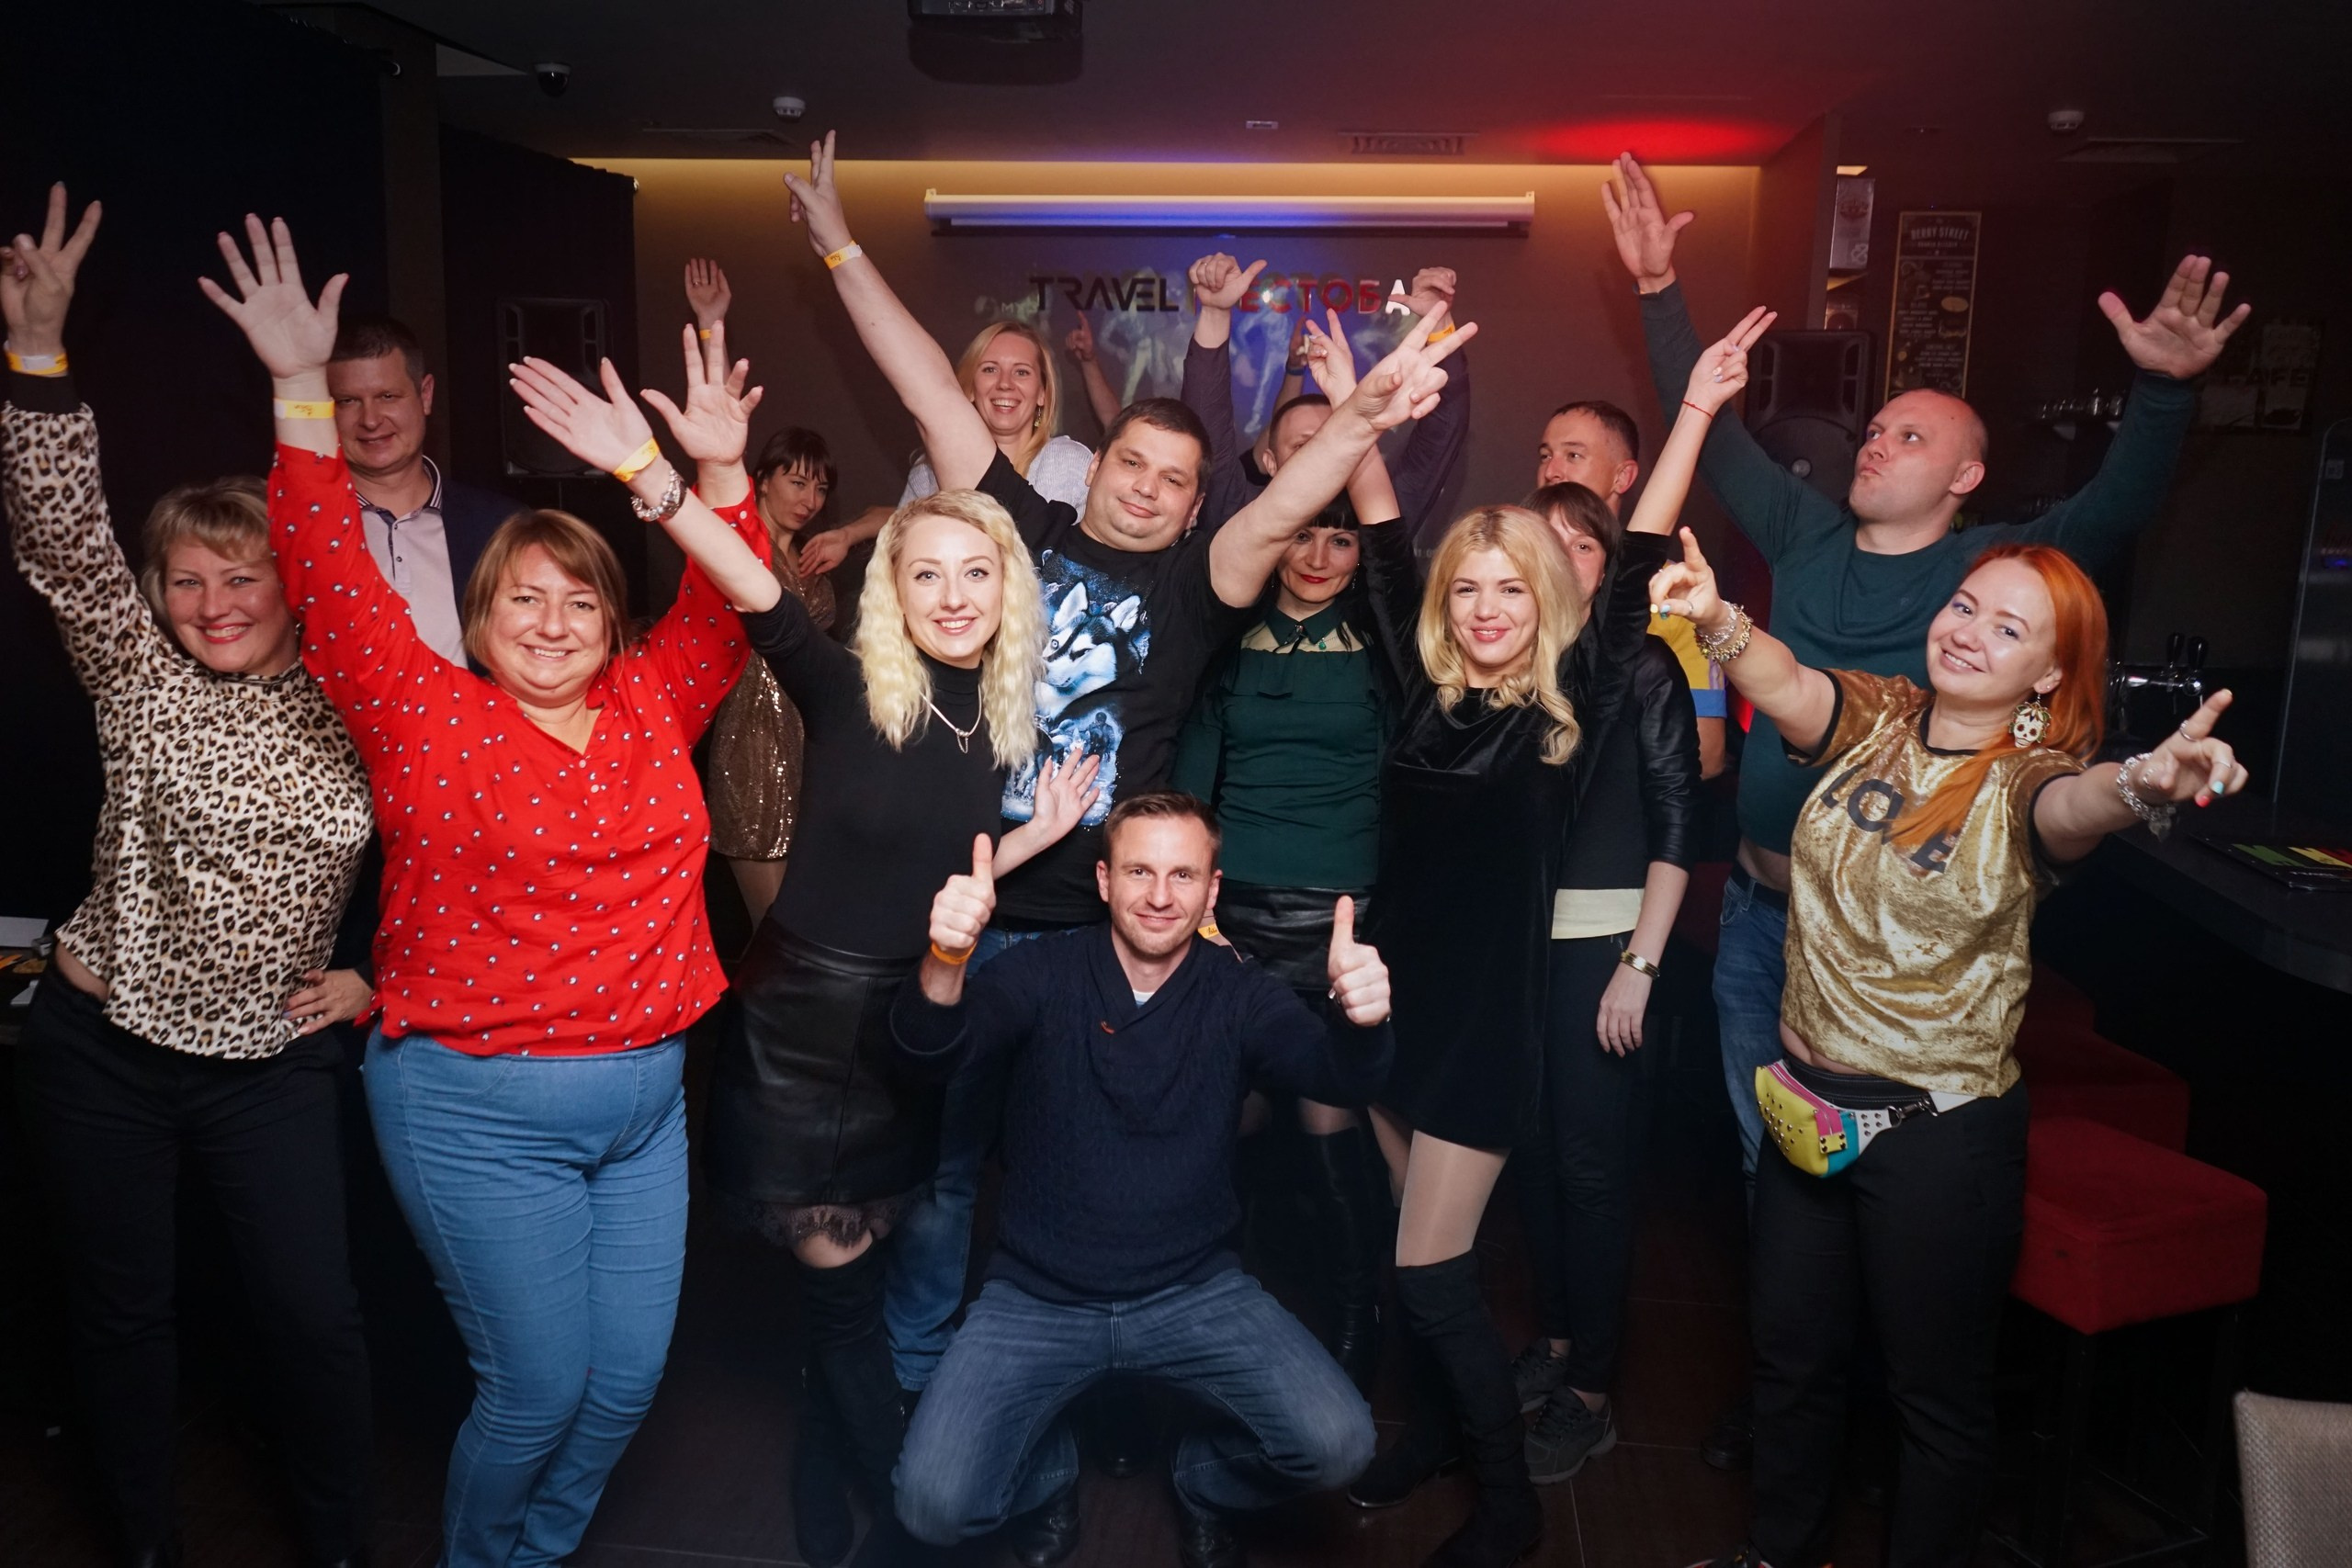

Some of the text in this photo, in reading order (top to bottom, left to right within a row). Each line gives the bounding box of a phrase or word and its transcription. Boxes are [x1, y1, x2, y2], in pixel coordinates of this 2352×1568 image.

[1939, 227, 1969, 241] STREET
[1029, 276, 1180, 312] TRAVEL
[1193, 278, 1412, 317] ЕСТОБА
